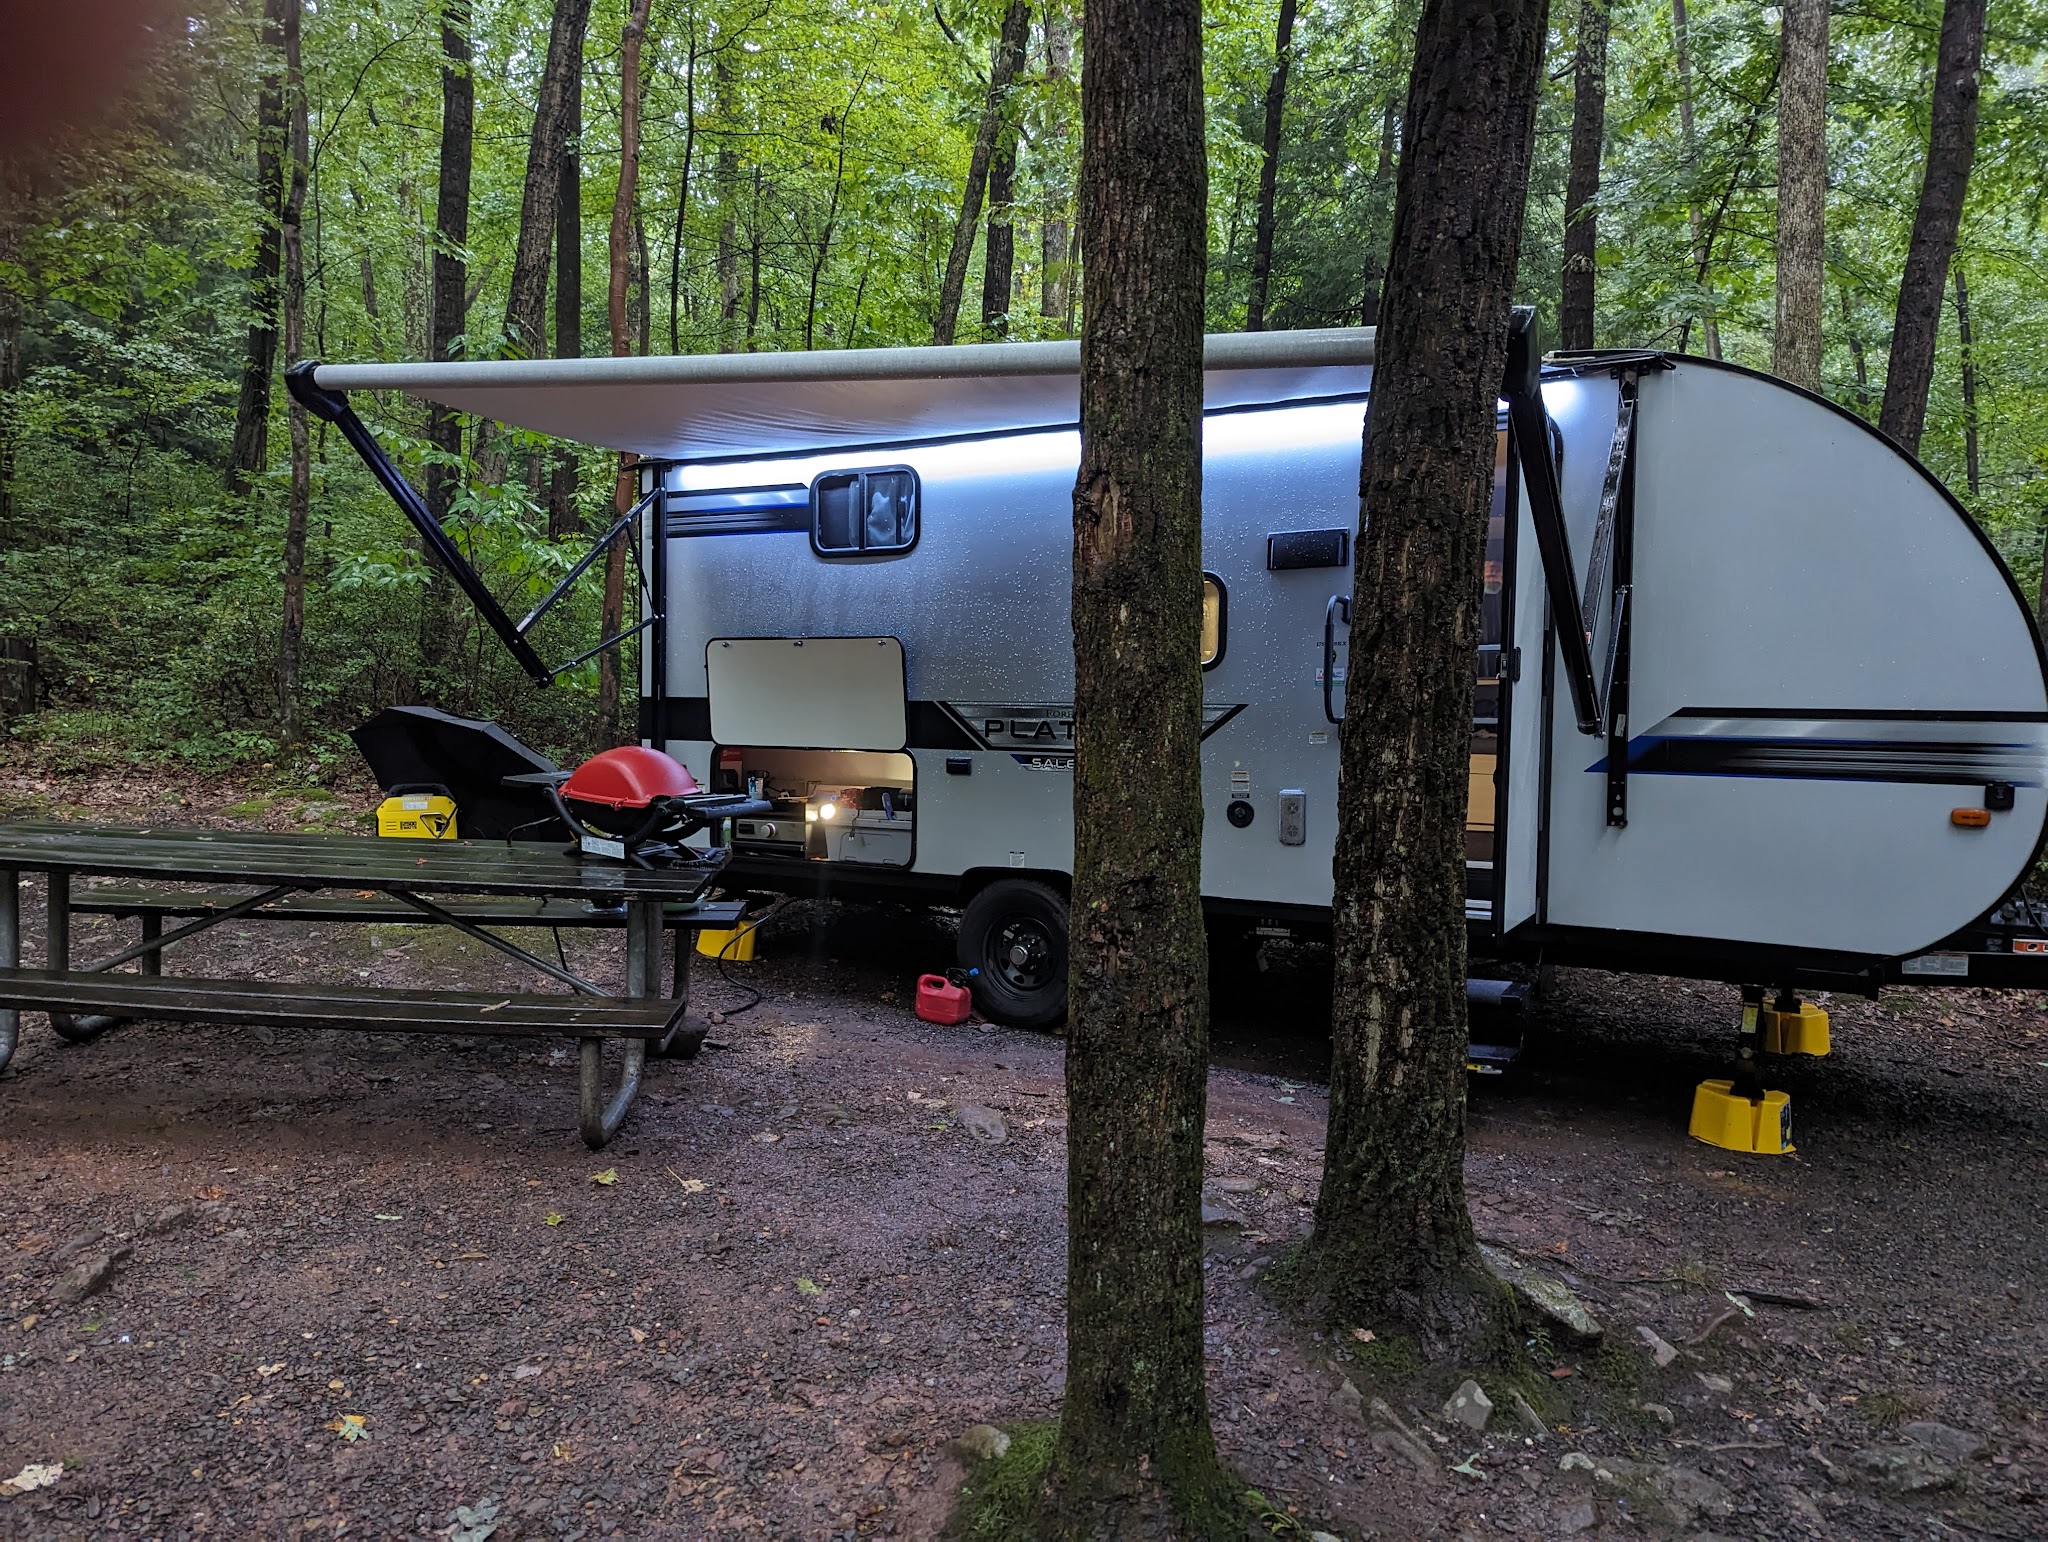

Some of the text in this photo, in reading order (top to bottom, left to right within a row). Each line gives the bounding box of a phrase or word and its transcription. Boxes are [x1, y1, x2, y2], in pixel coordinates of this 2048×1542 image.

[1046, 709, 1074, 718] FORE
[984, 719, 1075, 739] PLAT
[1032, 758, 1075, 769] SALE
